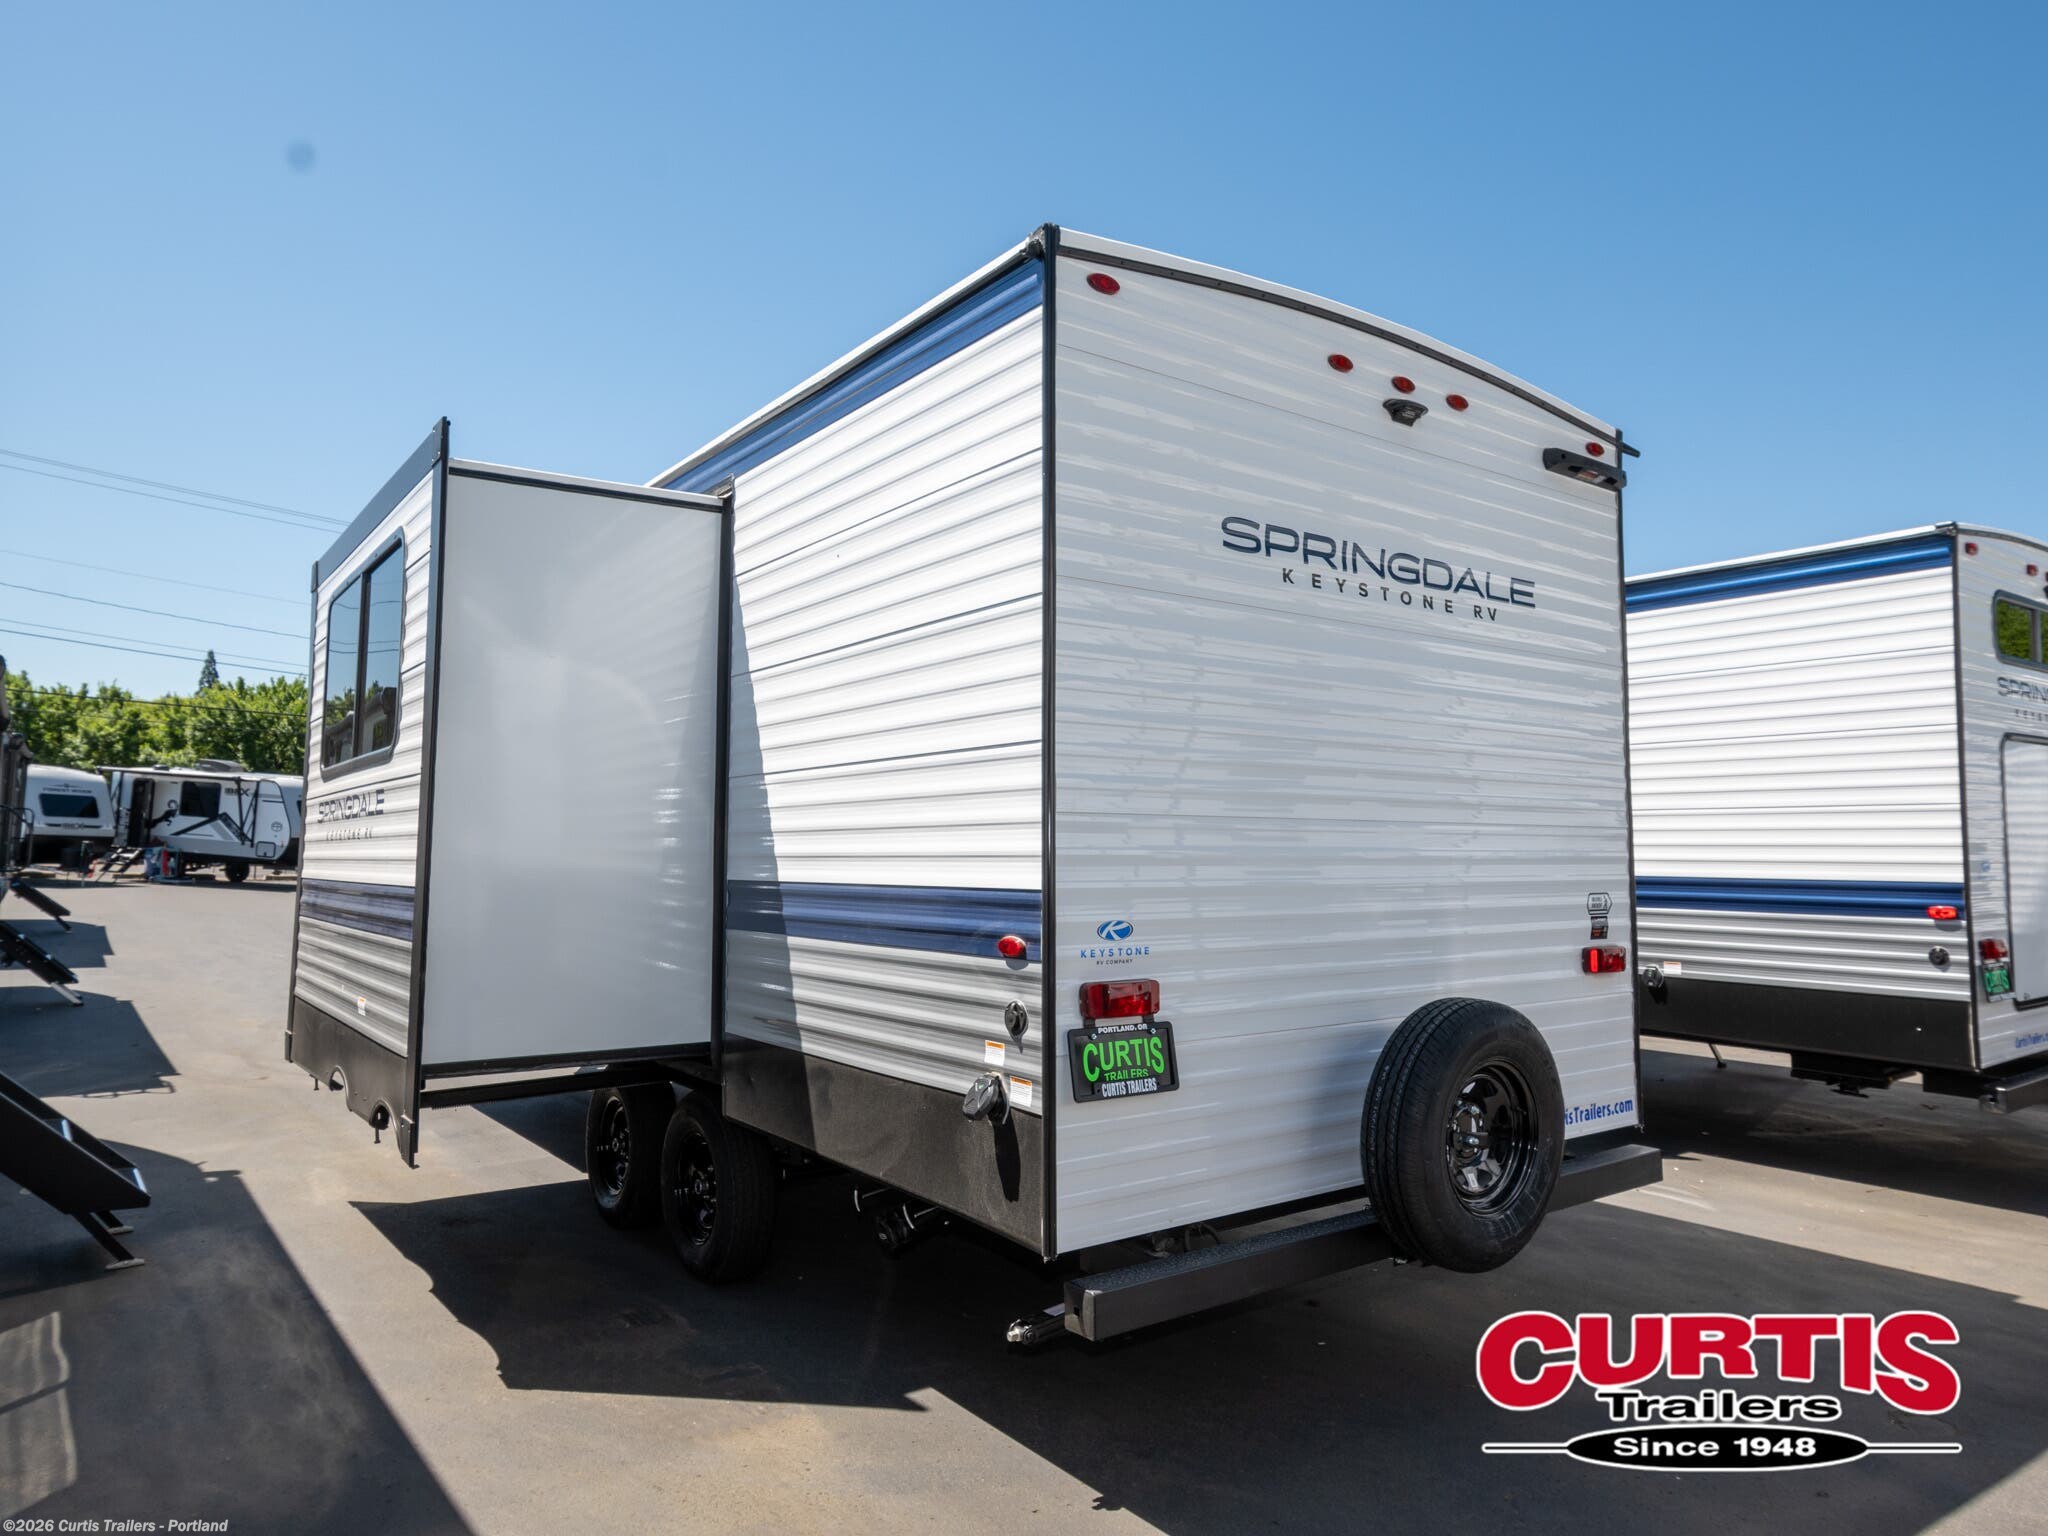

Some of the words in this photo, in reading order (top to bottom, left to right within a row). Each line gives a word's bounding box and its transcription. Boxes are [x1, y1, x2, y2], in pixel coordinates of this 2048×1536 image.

[1221, 516, 1536, 608] SPRINGDALE
[1282, 567, 1454, 614] KEYSTONE
[1473, 604, 1497, 621] RV
[317, 788, 385, 823] SPRINGDALE
[1080, 946, 1150, 958] KEYSTONE
[1083, 1036, 1165, 1082] CURTIS
[1101, 1081, 1126, 1098] CURTIS
[1126, 1077, 1157, 1094] TRAILERS
[1104, 1068, 1149, 1082] TRAILERS
[1564, 1099, 1633, 1125] isTrailers.com
